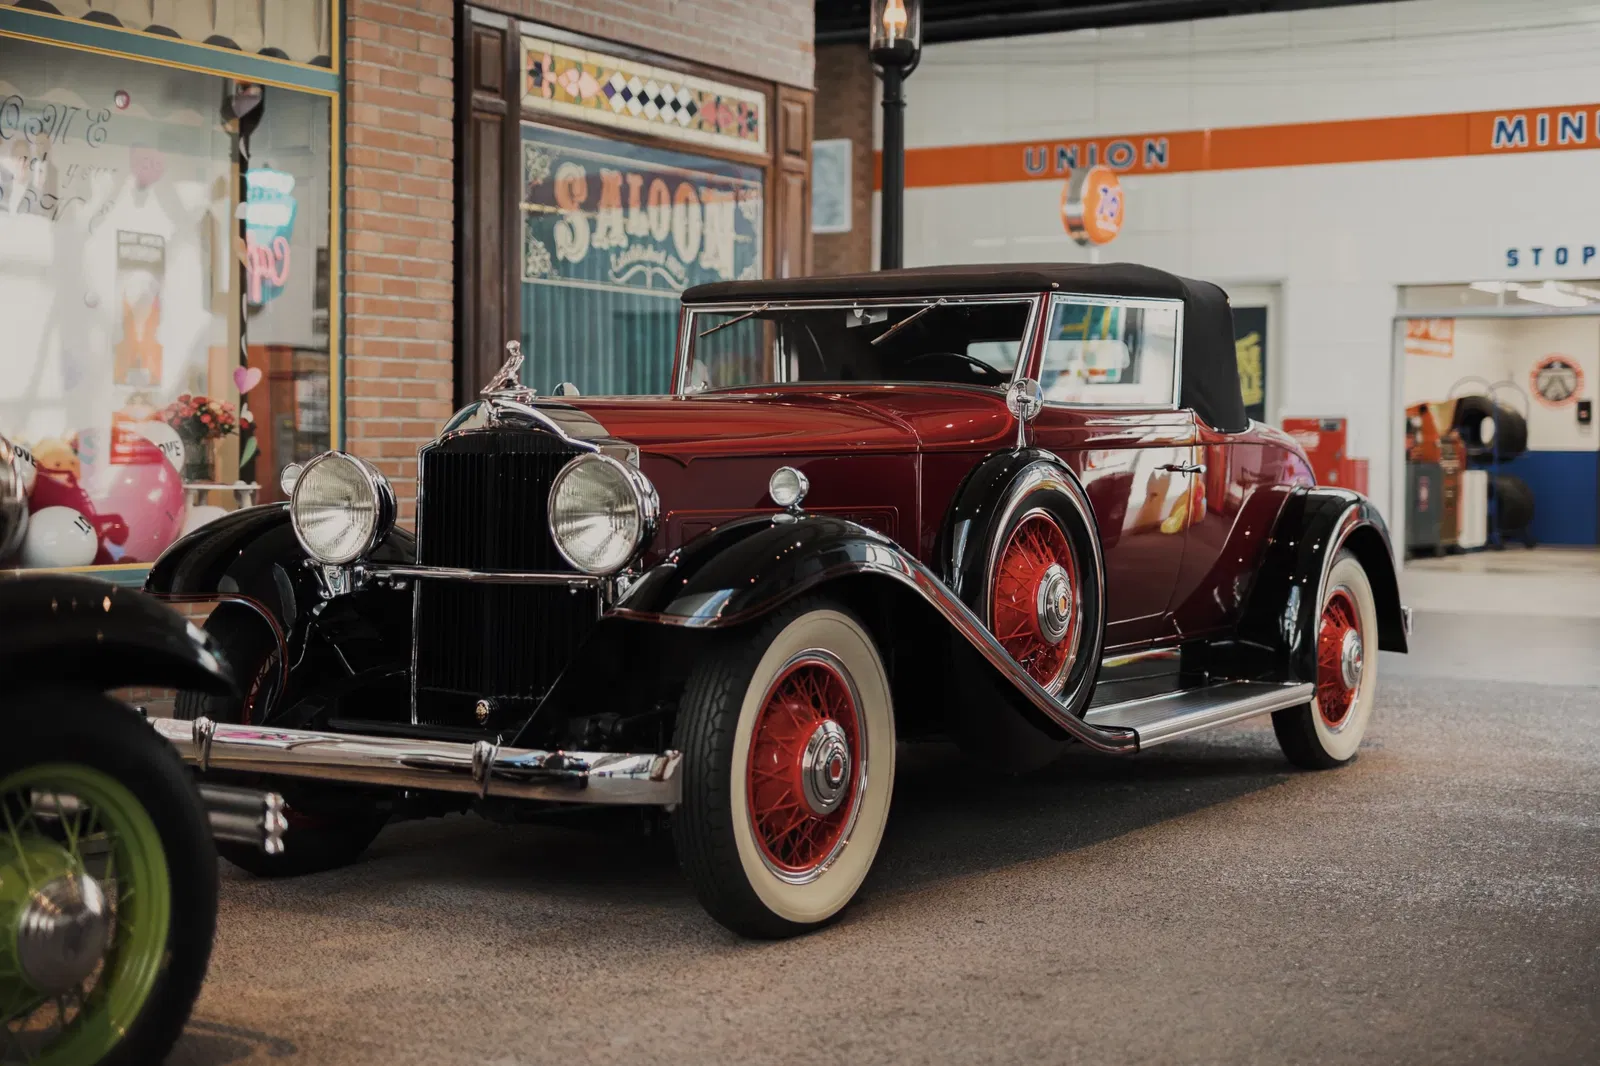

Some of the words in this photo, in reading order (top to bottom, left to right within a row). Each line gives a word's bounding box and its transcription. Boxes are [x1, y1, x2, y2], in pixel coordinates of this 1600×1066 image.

[1492, 111, 1600, 149] MIN
[1024, 138, 1169, 175] UNION
[554, 161, 737, 280] SALOON
[1506, 246, 1596, 267] STOP
[13, 445, 37, 469] OVE
